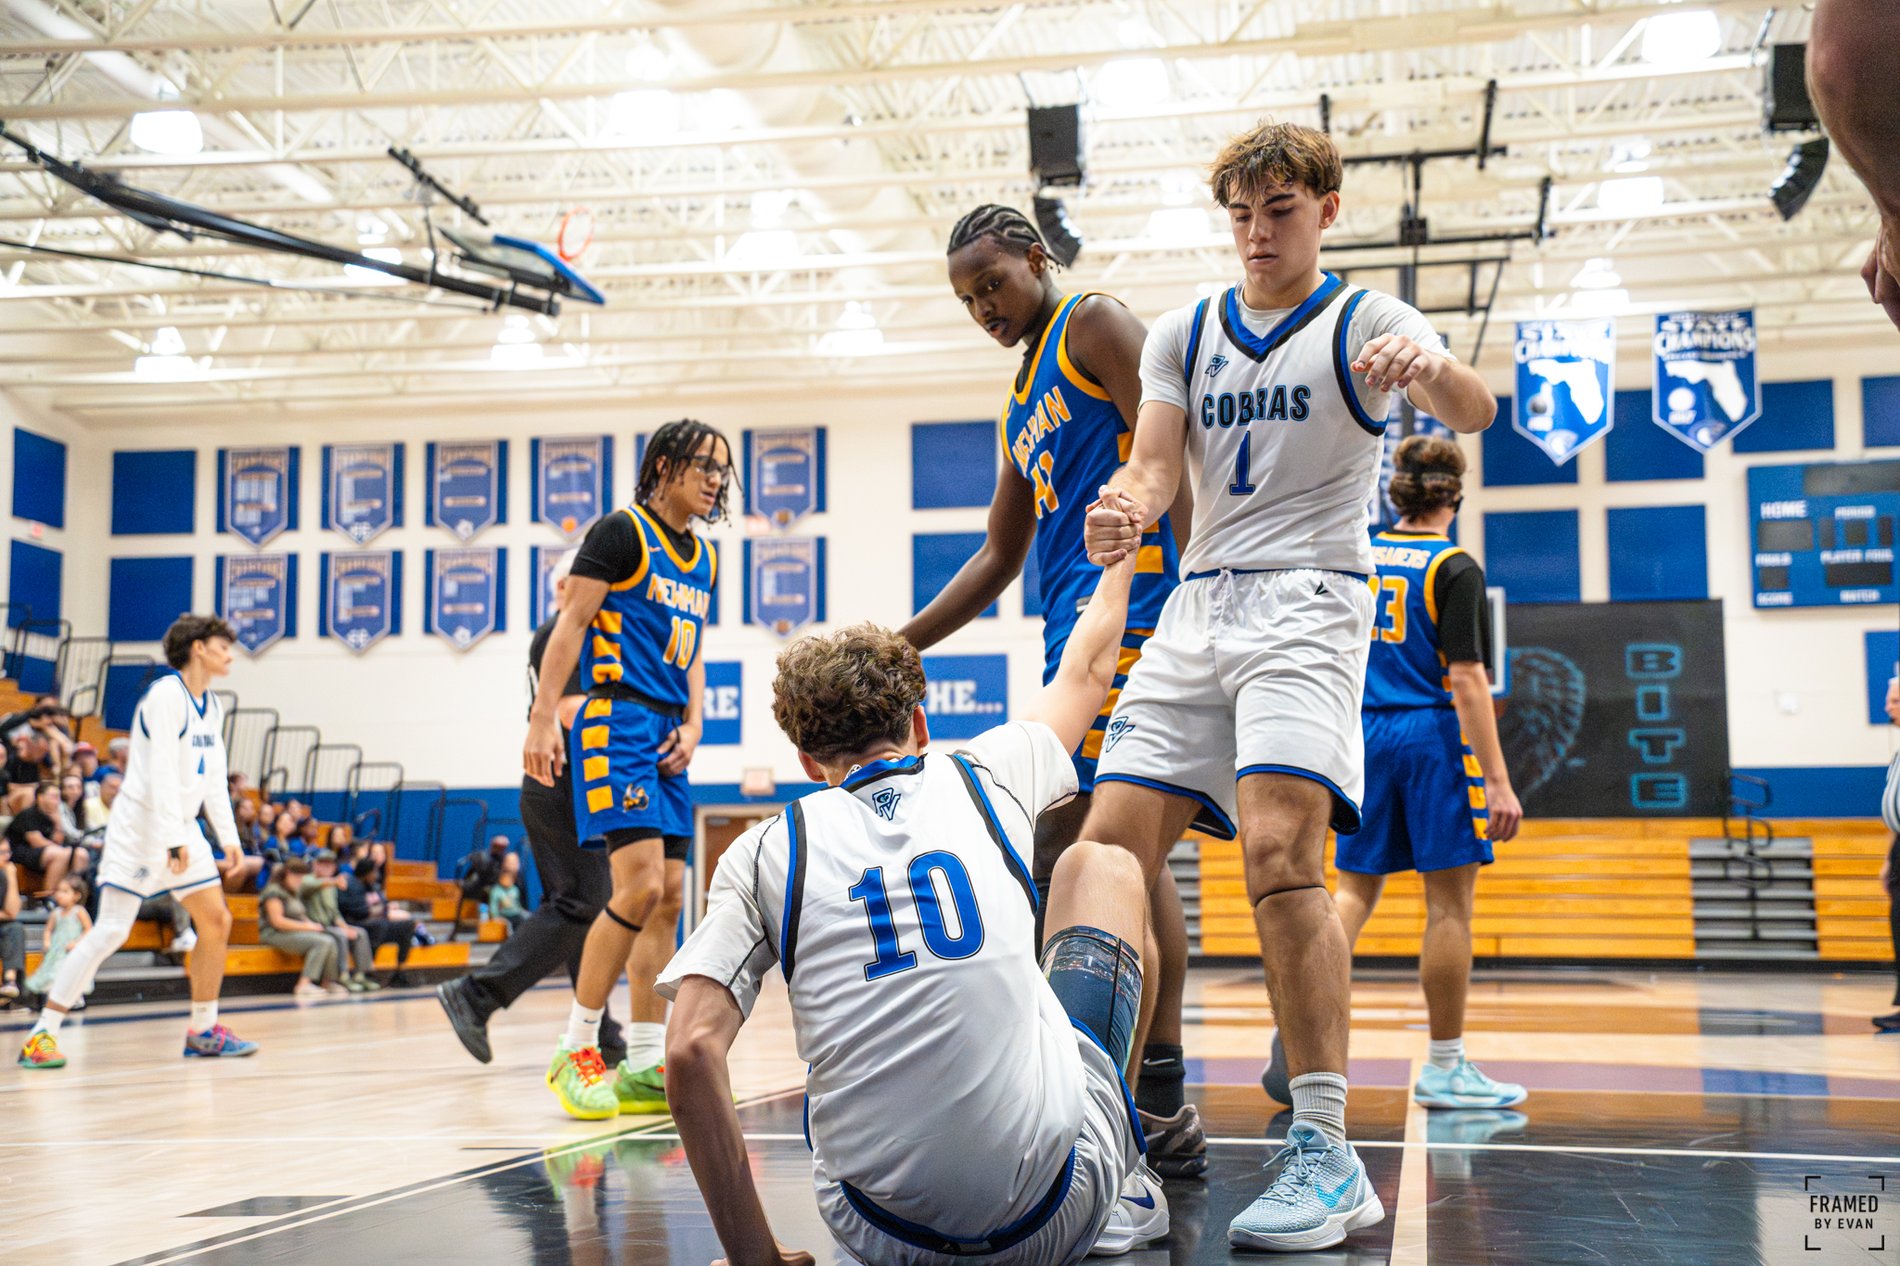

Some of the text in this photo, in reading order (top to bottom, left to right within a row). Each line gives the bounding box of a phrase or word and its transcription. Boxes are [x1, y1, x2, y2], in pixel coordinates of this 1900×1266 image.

[1655, 328, 1755, 358] CHAMPIONS
[1229, 430, 1256, 496] 1
[1760, 500, 1808, 520] HOME
[663, 615, 696, 671] 10
[848, 849, 985, 982] 10
